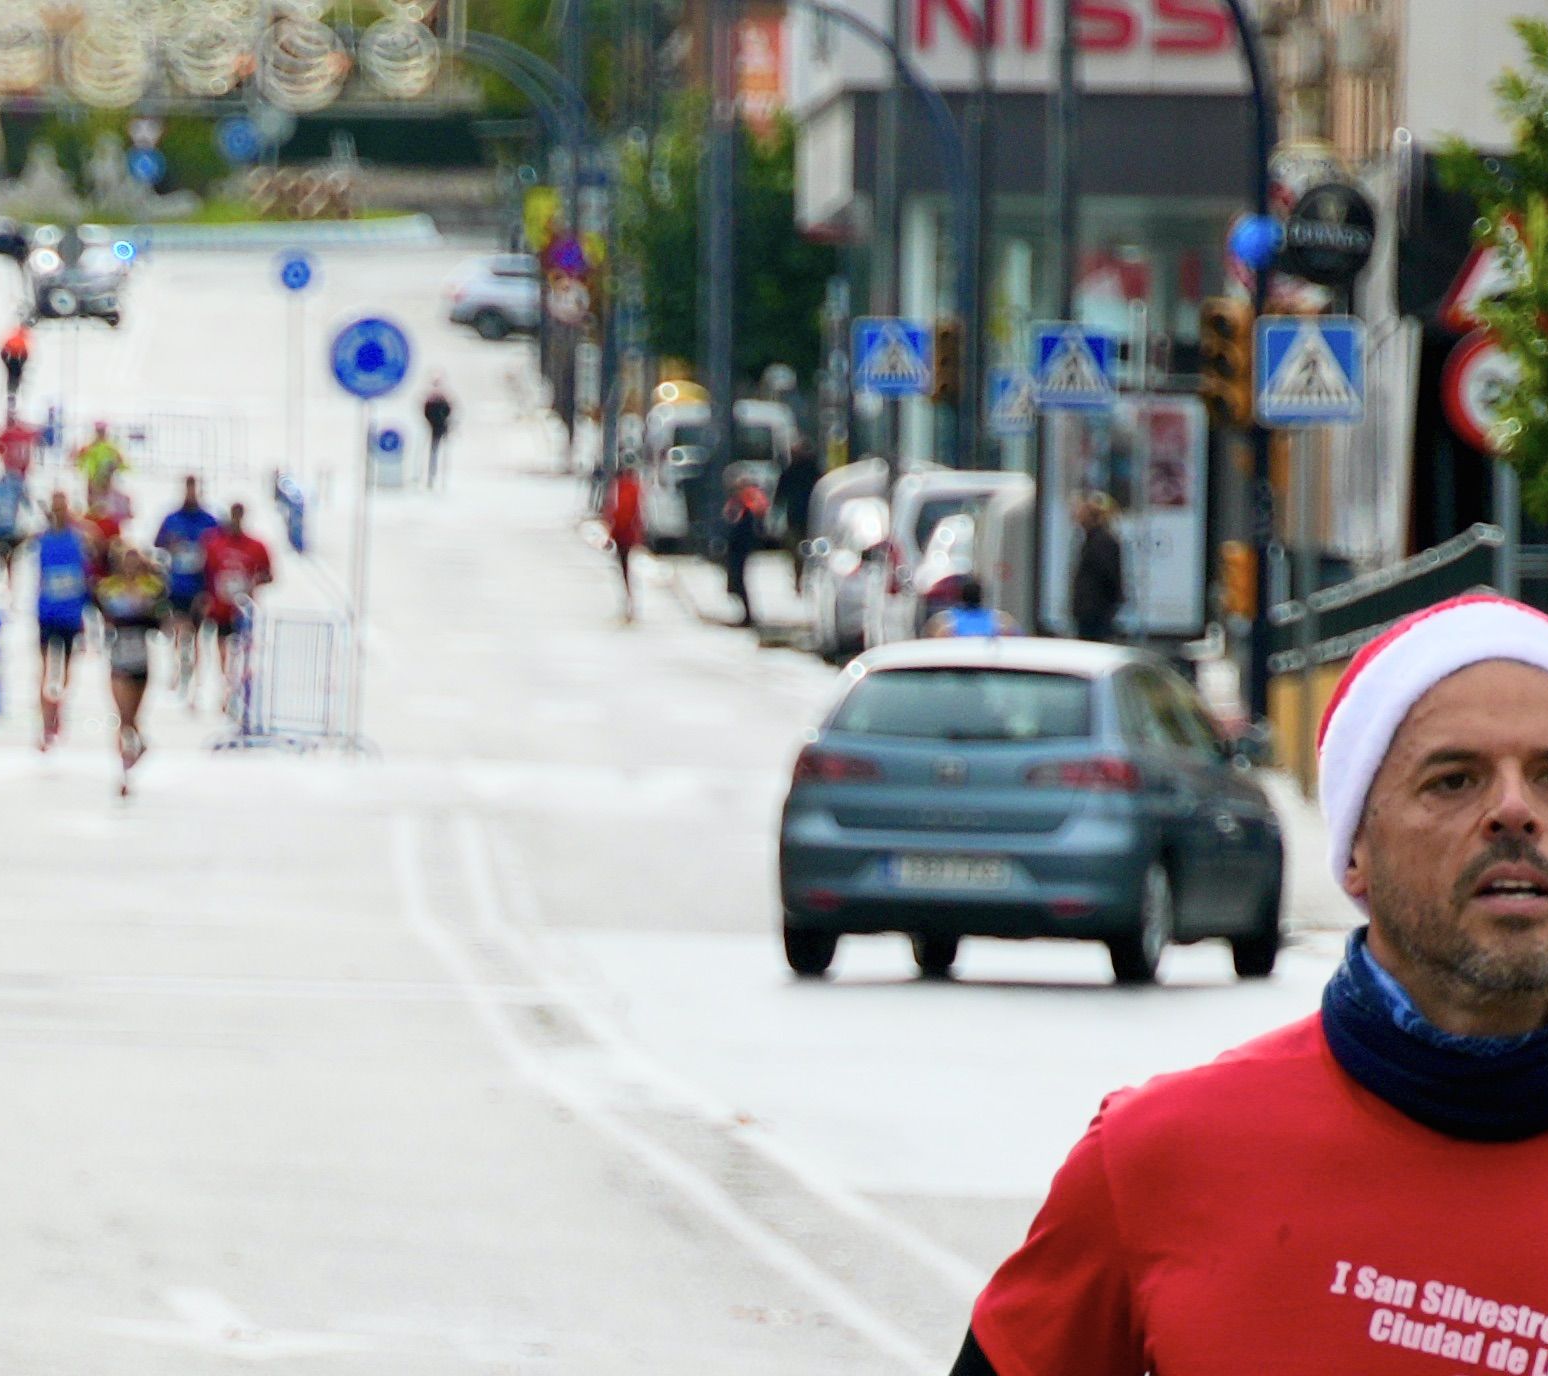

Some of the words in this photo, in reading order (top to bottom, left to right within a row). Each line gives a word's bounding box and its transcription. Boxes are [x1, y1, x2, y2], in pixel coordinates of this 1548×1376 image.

[1330, 1260, 1352, 1295] I
[1354, 1265, 1418, 1309] San
[1368, 1308, 1485, 1365] Ciudad
[1485, 1338, 1530, 1376] de
